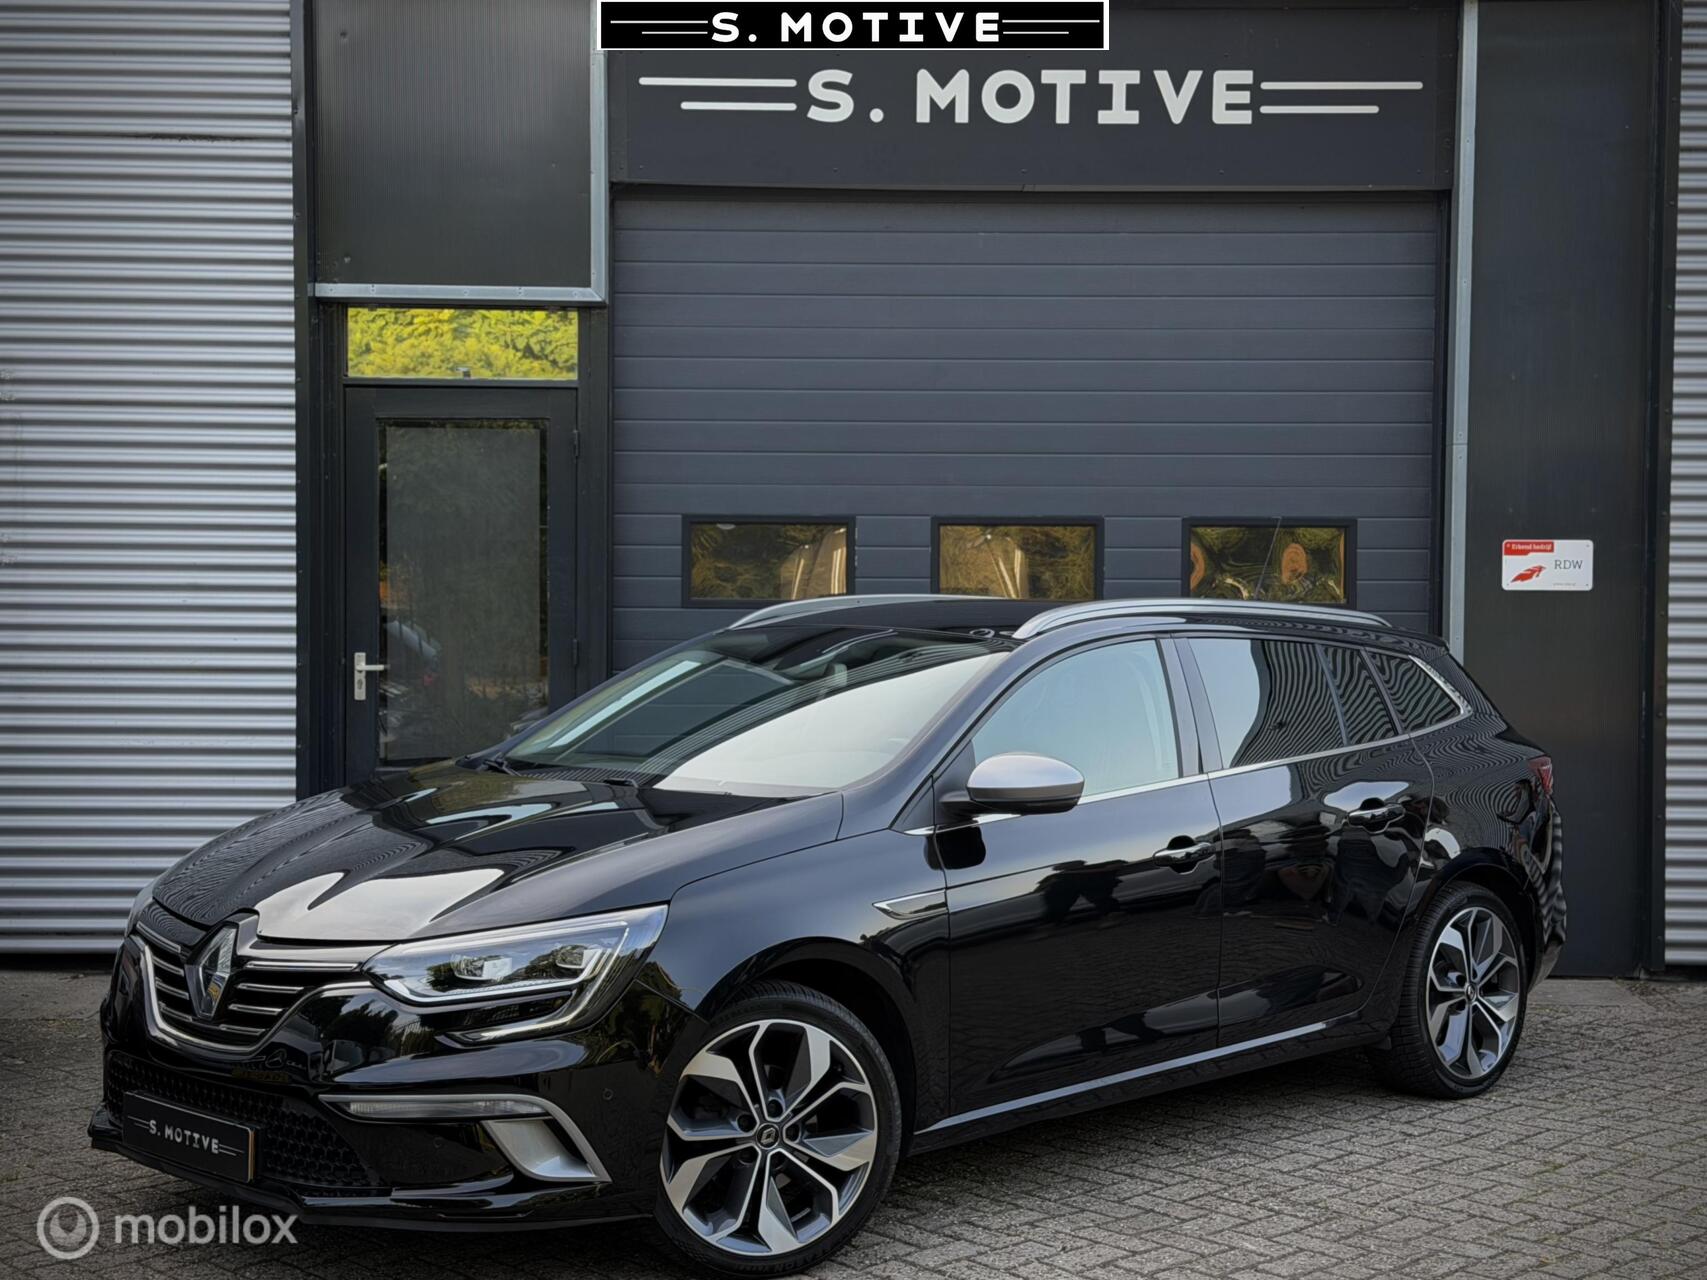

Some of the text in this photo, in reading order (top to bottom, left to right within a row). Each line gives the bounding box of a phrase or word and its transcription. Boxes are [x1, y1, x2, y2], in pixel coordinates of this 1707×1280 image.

[806, 69, 1254, 125] S. MOTIVE
[1554, 559, 1583, 570] RDW
[149, 1119, 219, 1155] S. MOTIVE
